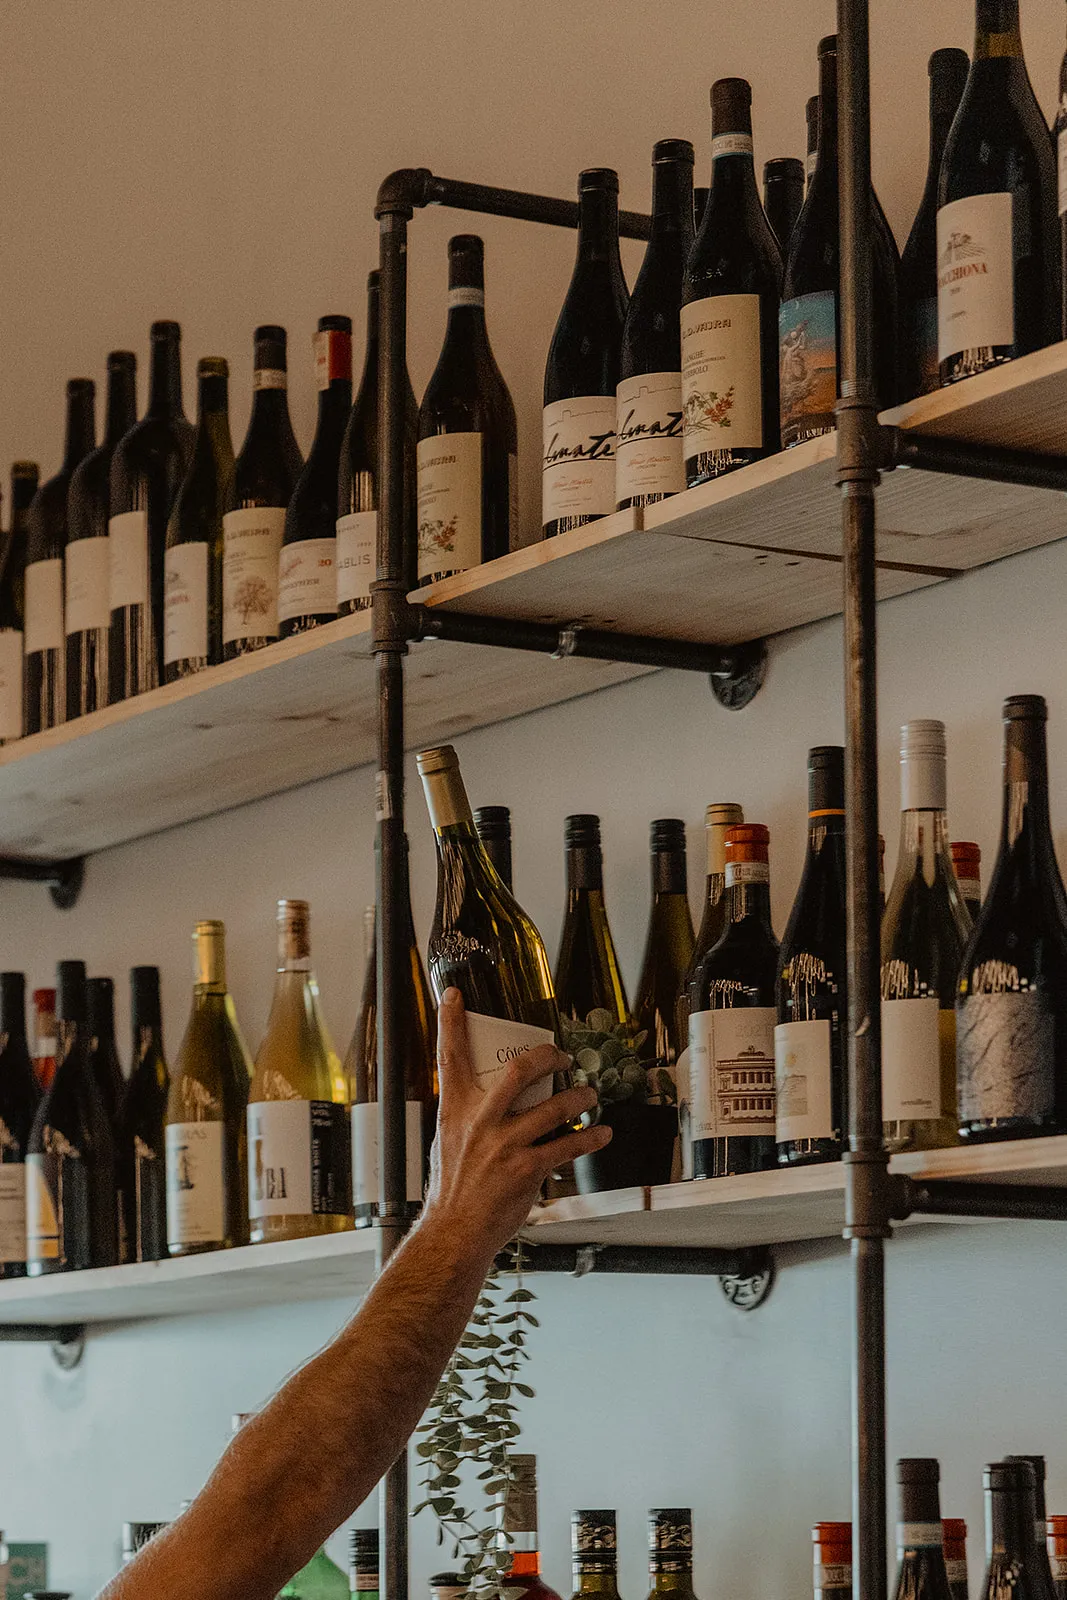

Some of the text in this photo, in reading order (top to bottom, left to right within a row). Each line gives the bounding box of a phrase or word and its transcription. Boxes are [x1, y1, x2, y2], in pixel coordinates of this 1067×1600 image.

[938, 263, 988, 288] ACCHIONA
[338, 554, 372, 569] ABLIS
[496, 1044, 530, 1064] Côtes
